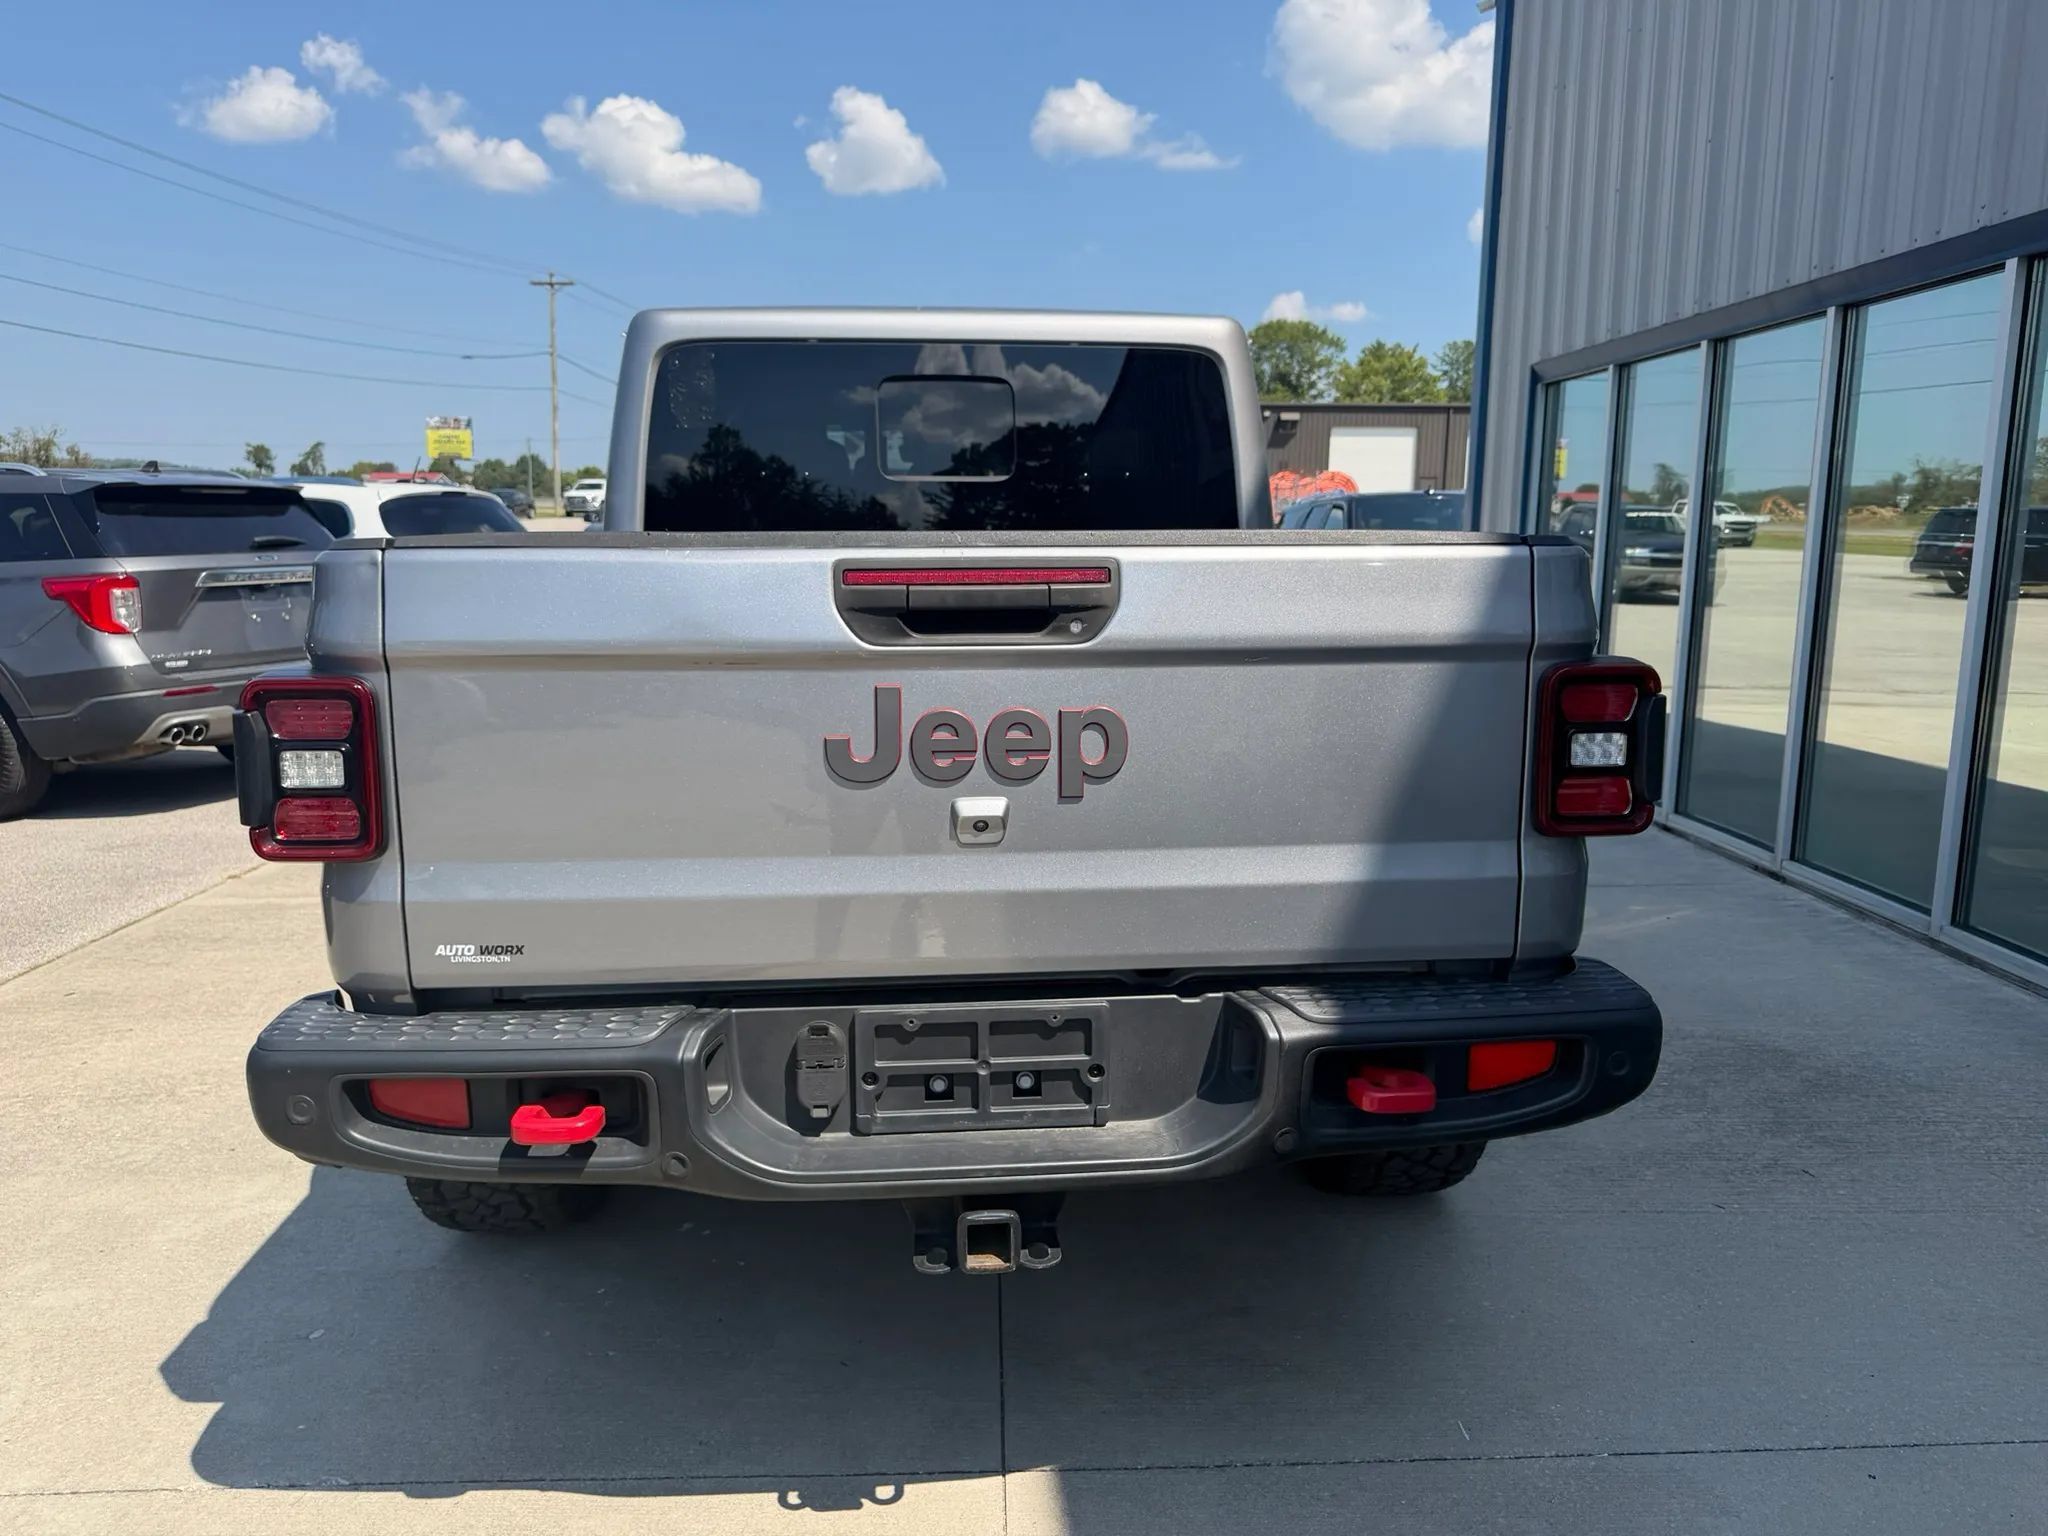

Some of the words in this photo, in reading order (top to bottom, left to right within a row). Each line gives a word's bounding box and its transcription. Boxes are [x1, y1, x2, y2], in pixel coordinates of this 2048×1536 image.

[823, 682, 1129, 801] Jeep
[435, 944, 475, 956] AUTO
[479, 944, 525, 956] WORX
